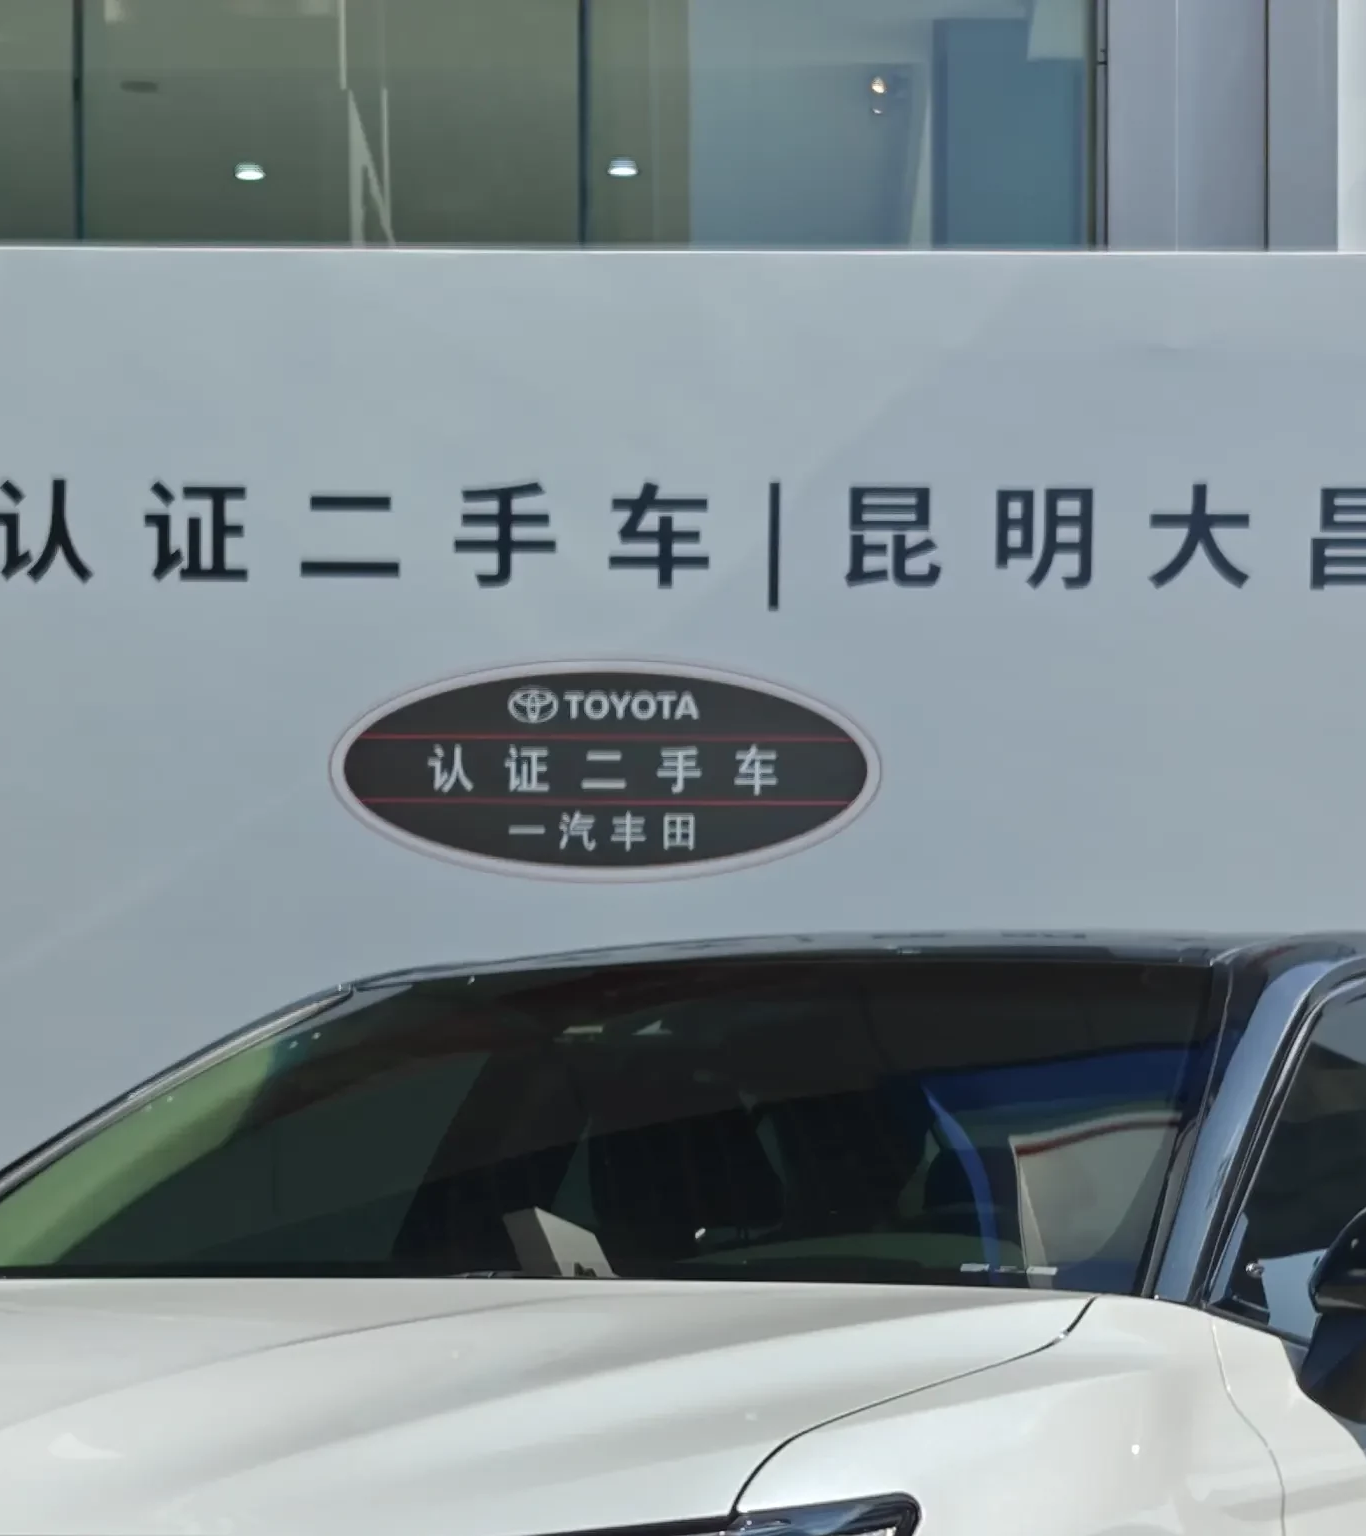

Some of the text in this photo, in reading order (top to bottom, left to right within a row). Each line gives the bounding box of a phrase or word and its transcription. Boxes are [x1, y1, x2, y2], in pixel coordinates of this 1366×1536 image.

[564, 691, 701, 721] TOYOTA
[428, 743, 778, 796] 认证二手车
[508, 810, 697, 852] 一汽丰田
